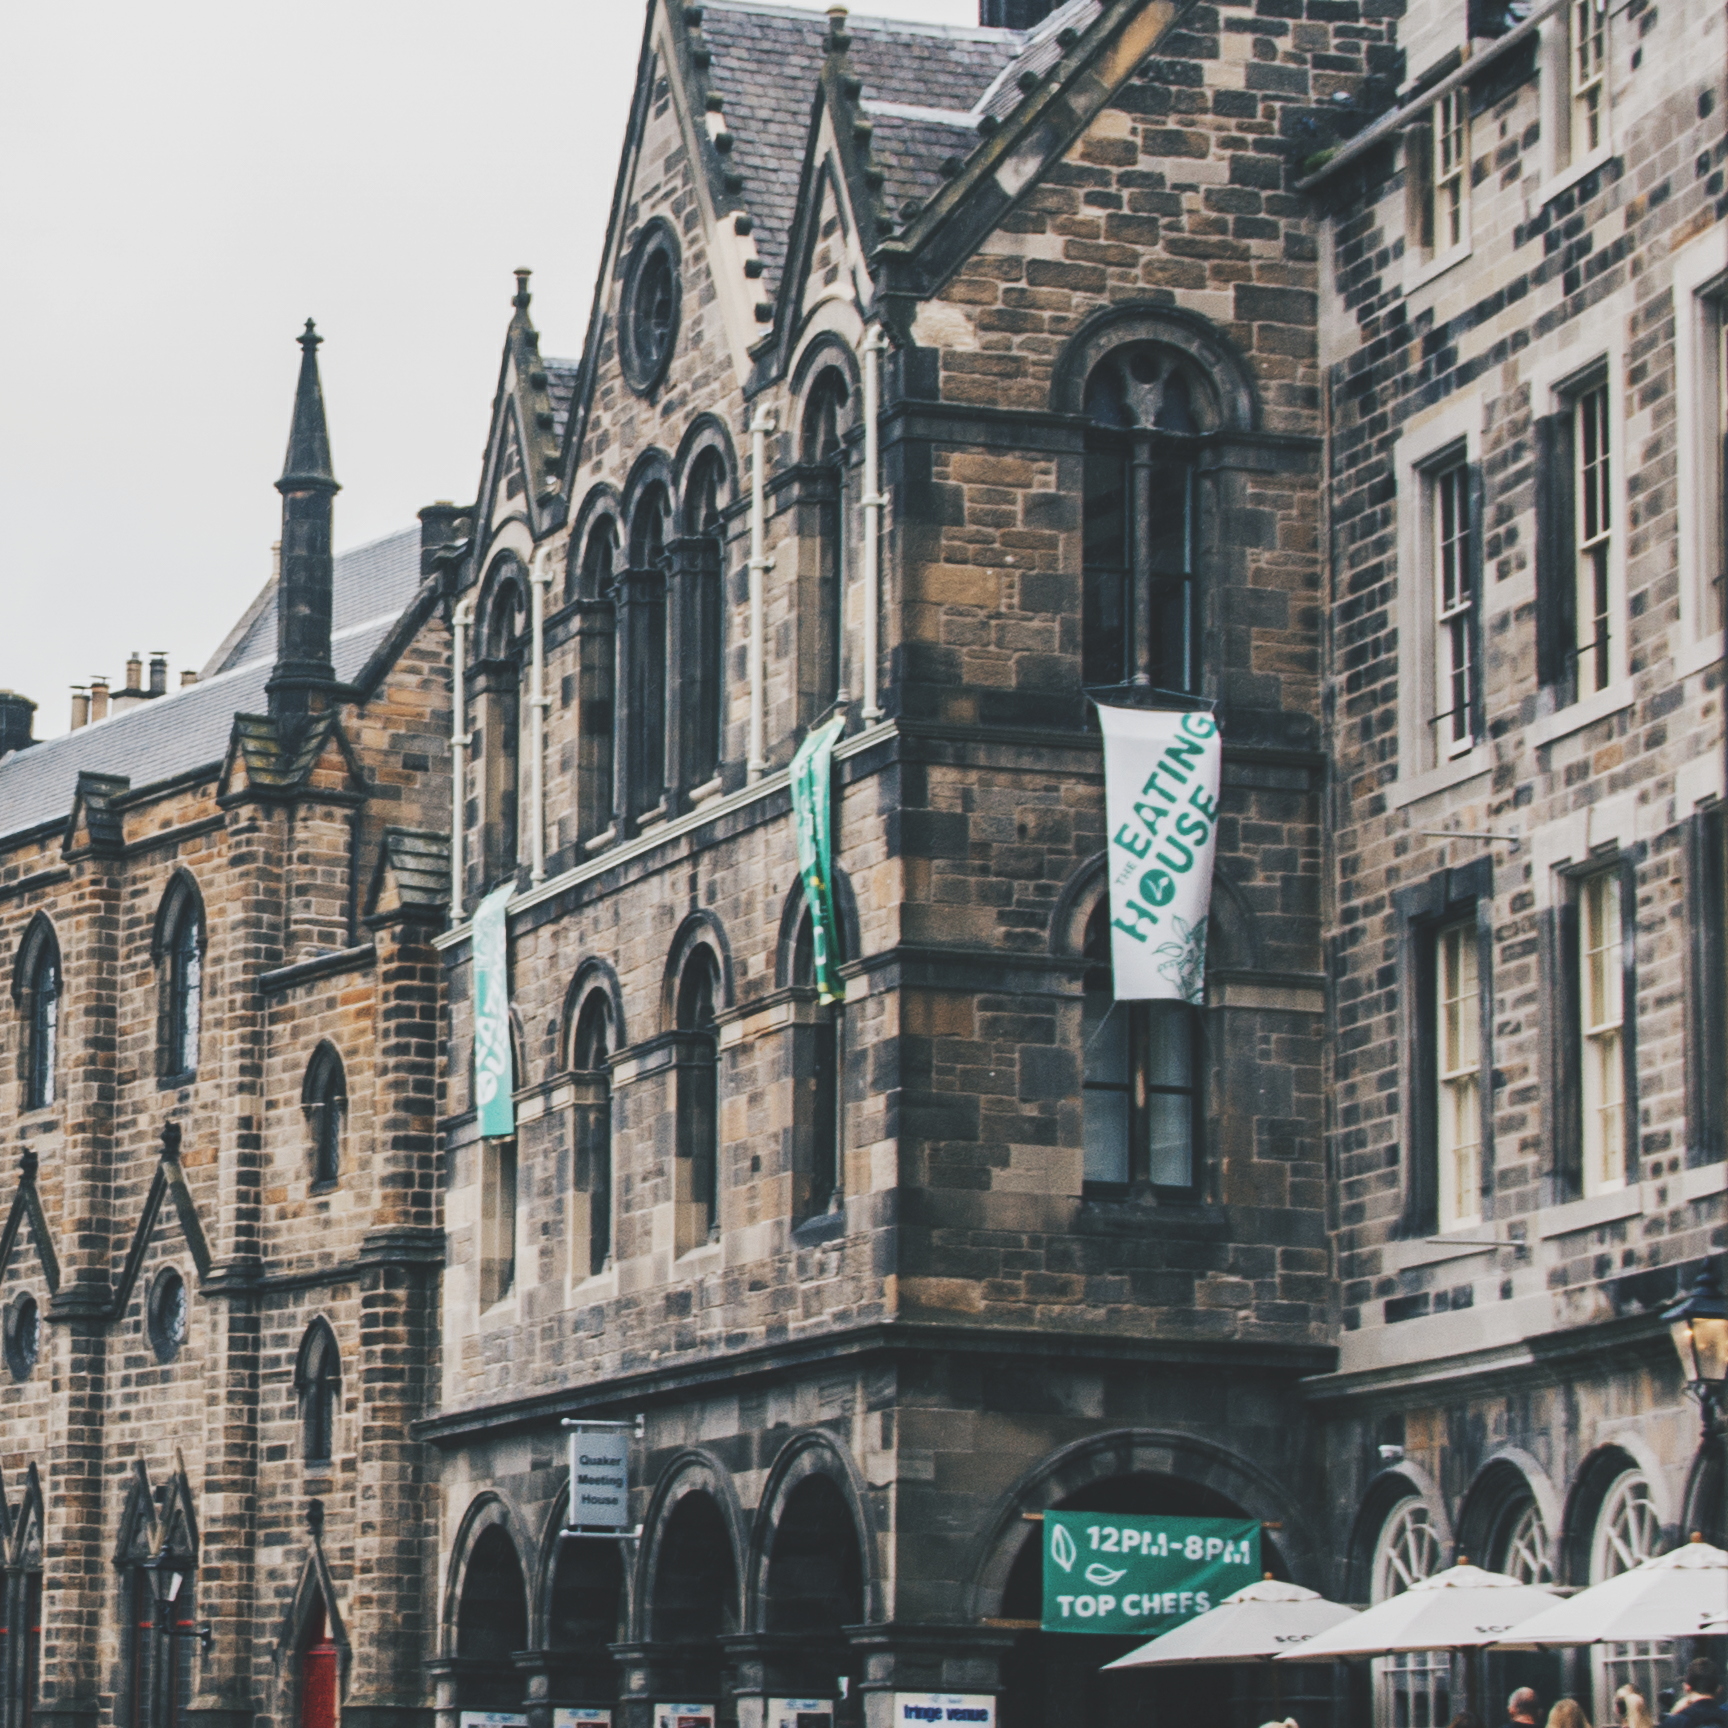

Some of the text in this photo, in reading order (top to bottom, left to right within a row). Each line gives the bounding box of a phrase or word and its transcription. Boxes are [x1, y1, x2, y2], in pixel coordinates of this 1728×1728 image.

[1113, 713, 1218, 860] EATING
[1112, 784, 1219, 943] HOUSE
[1115, 860, 1138, 887] THE
[579, 1455, 621, 1466] Quaker
[577, 1474, 623, 1488] Meeting
[581, 1494, 619, 1505] House
[1086, 1526, 1251, 1565] 12PM-8PM
[1056, 1592, 1211, 1619] TOP CHEFS
[904, 1704, 989, 1724] fringe venue
